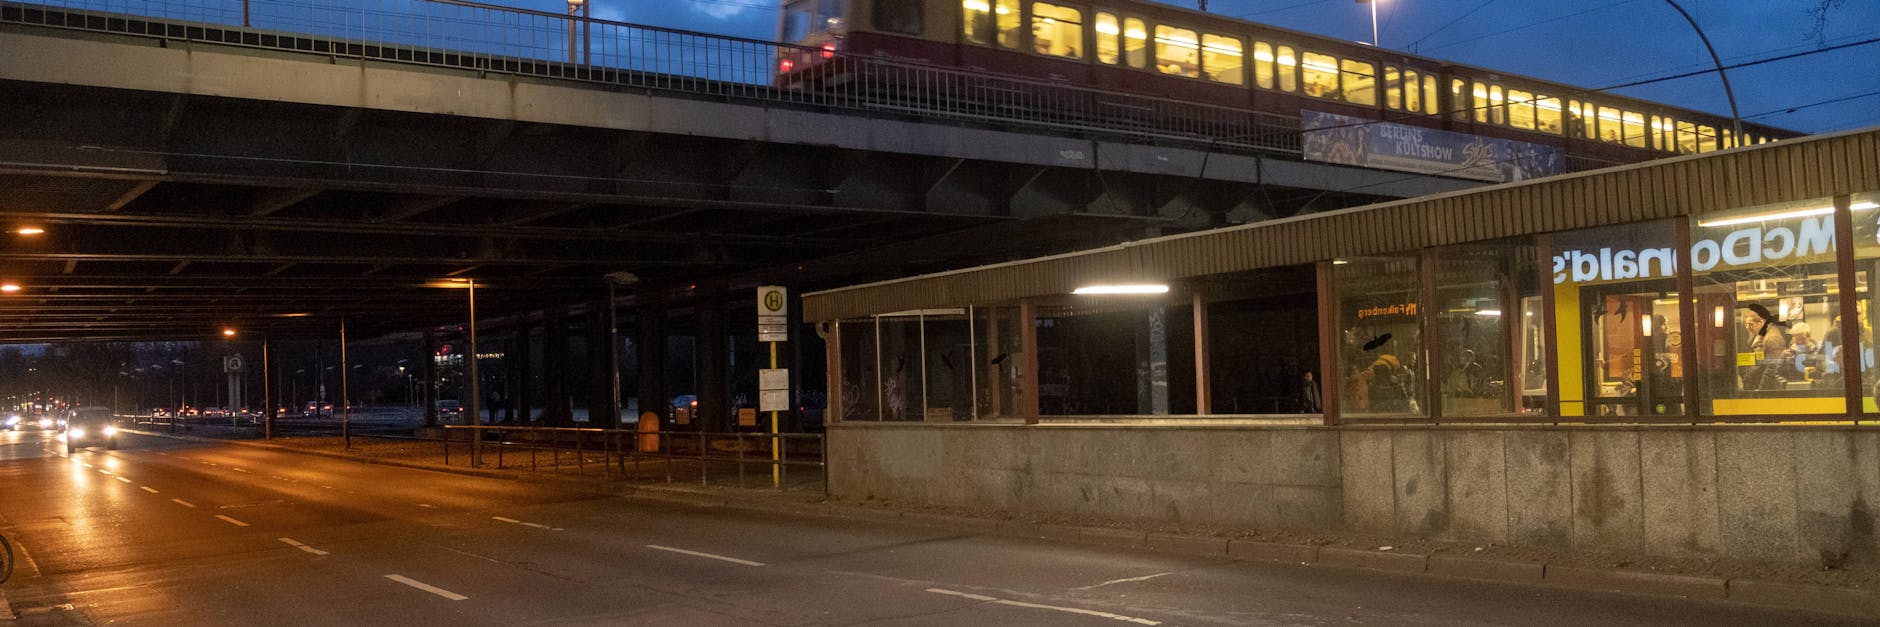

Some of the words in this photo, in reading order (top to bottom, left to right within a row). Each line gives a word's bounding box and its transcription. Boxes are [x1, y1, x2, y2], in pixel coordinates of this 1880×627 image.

[1380, 124, 1423, 143] BERLINS
[1396, 141, 1453, 160] KULTSHOW
[770, 294, 779, 307] H
